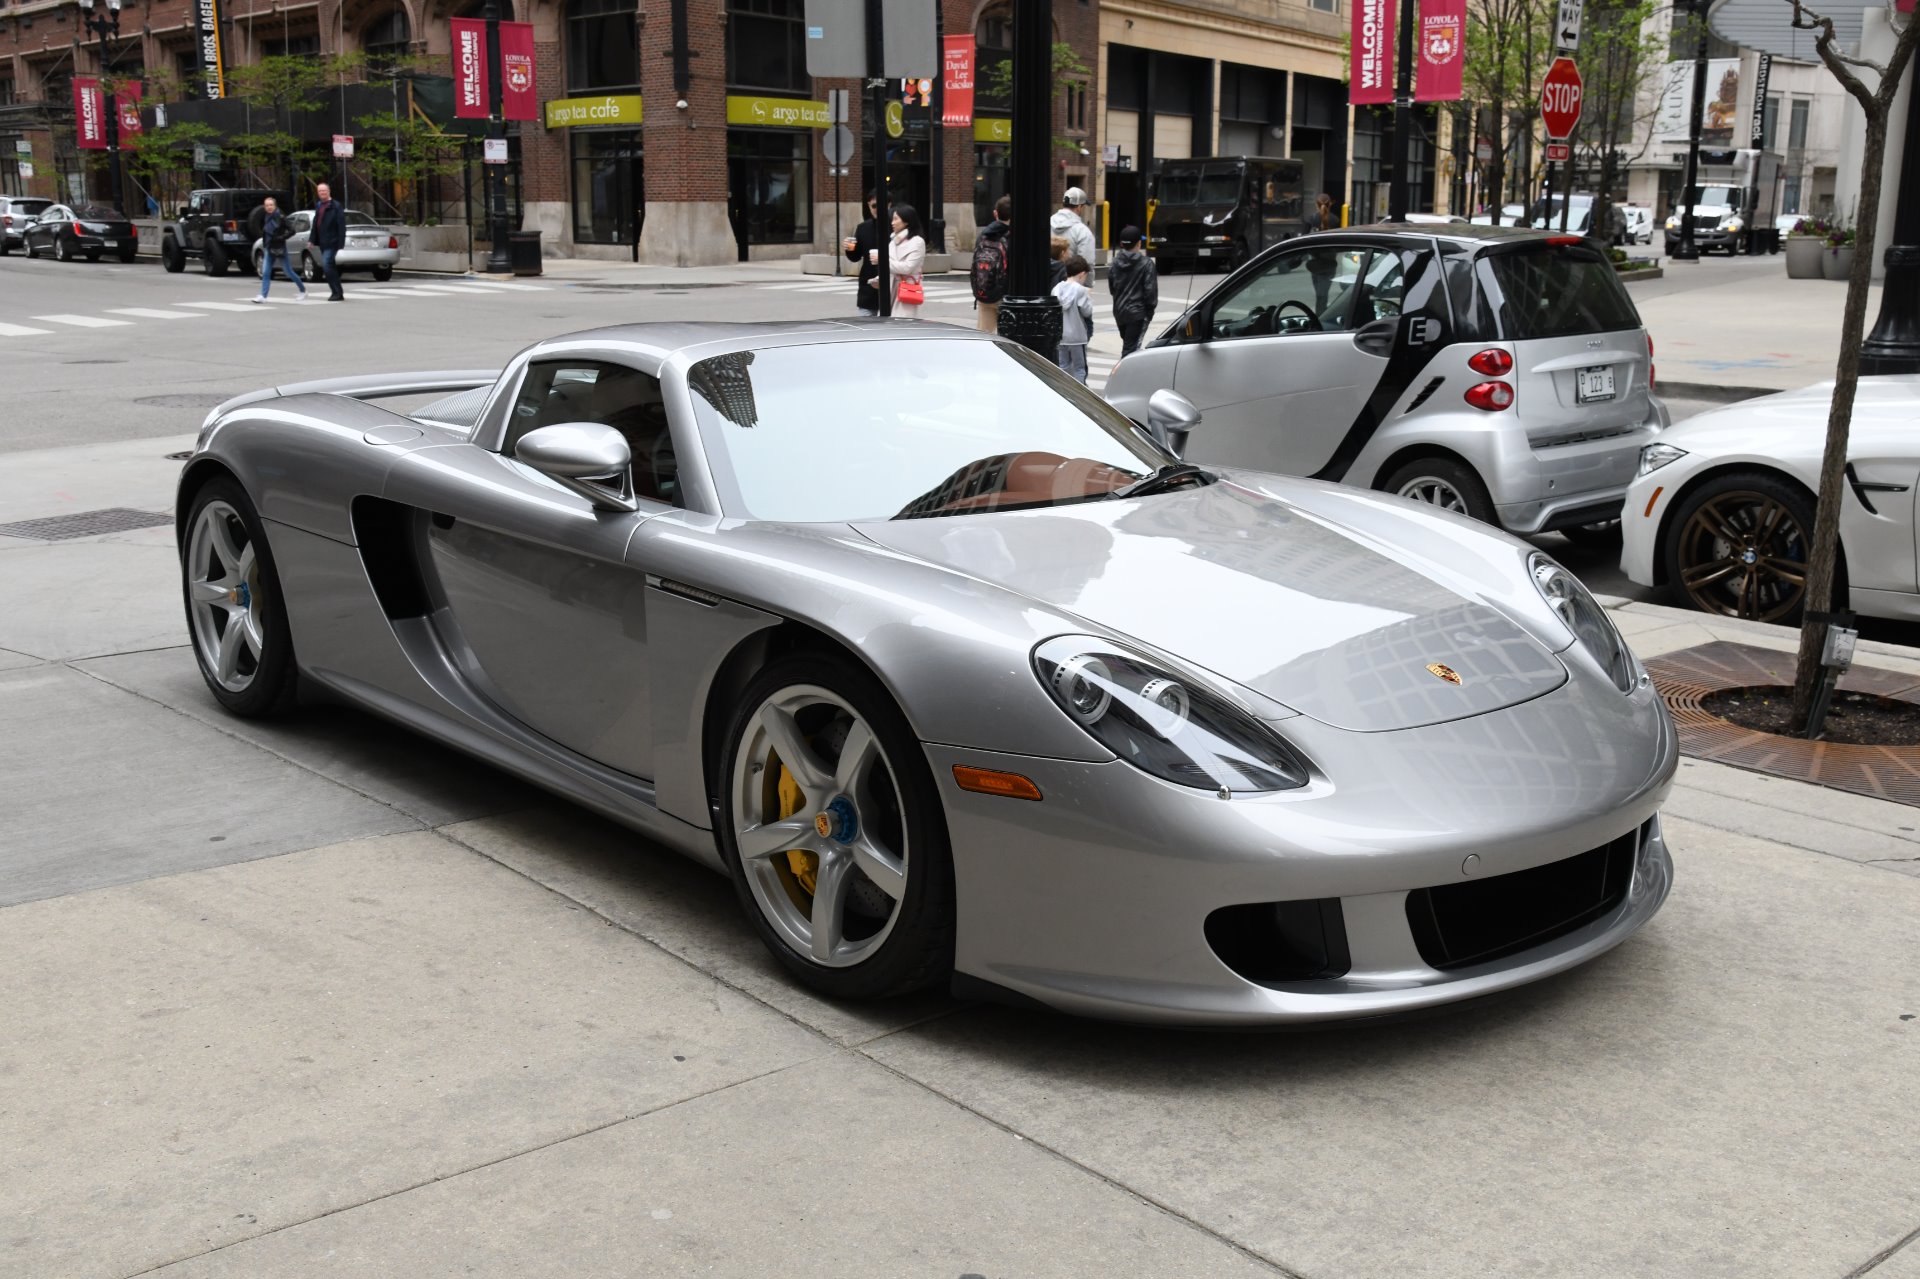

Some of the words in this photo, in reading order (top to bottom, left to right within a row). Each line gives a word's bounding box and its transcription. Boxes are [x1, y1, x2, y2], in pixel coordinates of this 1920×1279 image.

[1424, 15, 1459, 25] LOYOLA
[1561, 8, 1580, 24] WAY
[203, 34, 217, 62] BROS.
[1362, 0, 1376, 88] WELCOME
[1376, 30, 1384, 59] TOWER
[461, 31, 475, 106] WELCOME
[505, 54, 531, 62] LOYOLA
[946, 60, 968, 70] David
[954, 70, 969, 79] Lee
[590, 97, 620, 118] café
[1544, 82, 1580, 114] STOP
[81, 87, 95, 140] WELCOME
[773, 107, 799, 124] argo
[801, 107, 815, 121] tea
[1752, 114, 1764, 140] rack
[1590, 375, 1603, 393] 123
